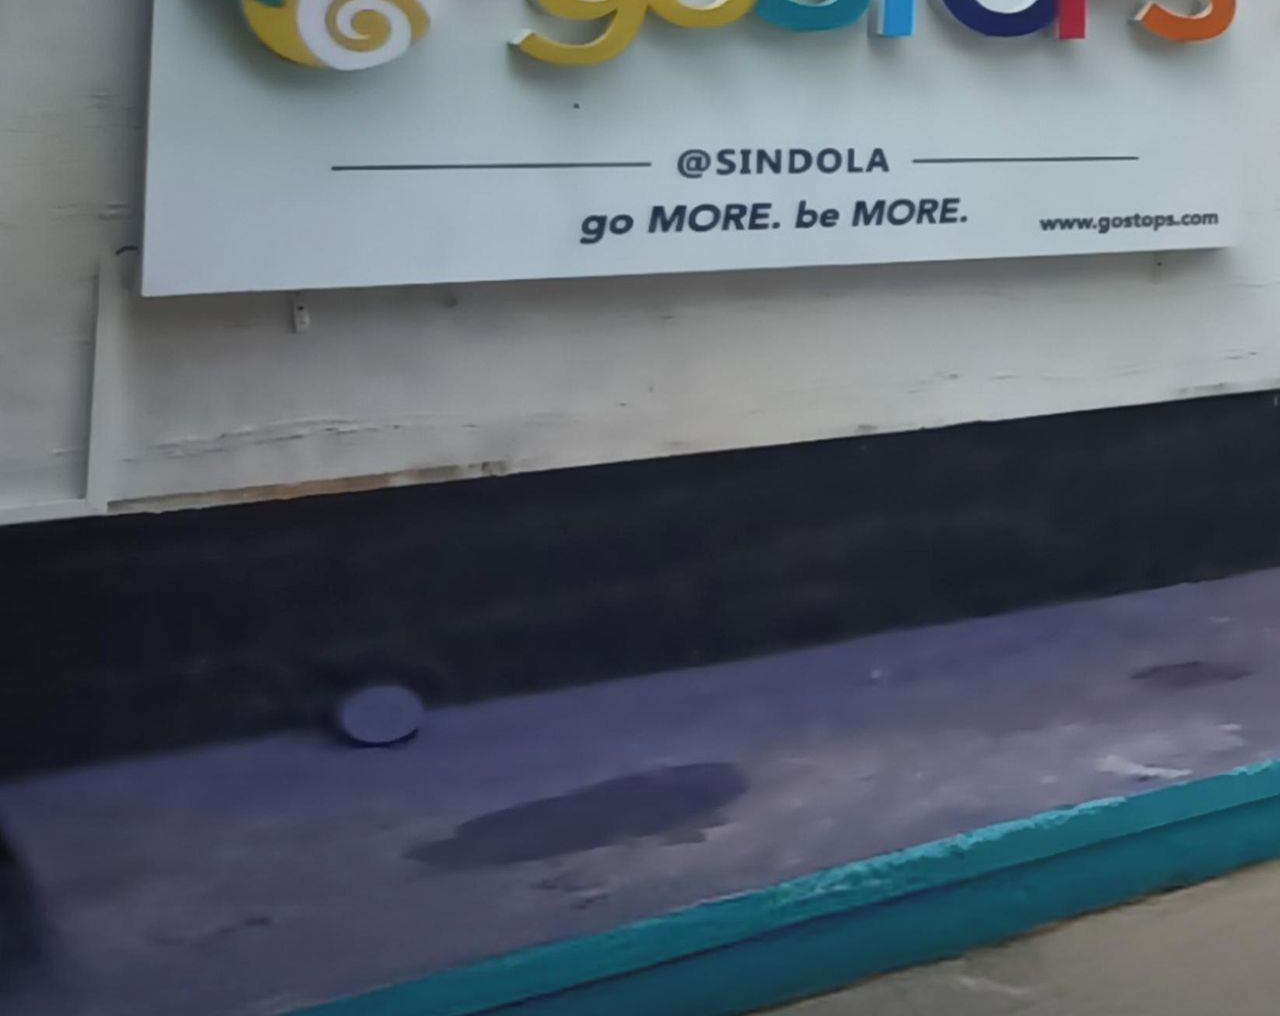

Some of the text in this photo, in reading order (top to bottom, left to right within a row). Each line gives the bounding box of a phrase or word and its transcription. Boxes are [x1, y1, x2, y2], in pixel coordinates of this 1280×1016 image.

[677, 148, 890, 179] @SINDOLA
[579, 197, 969, 245] go MORE. be MORE.
[1039, 212, 1219, 234] www.gostops.com
